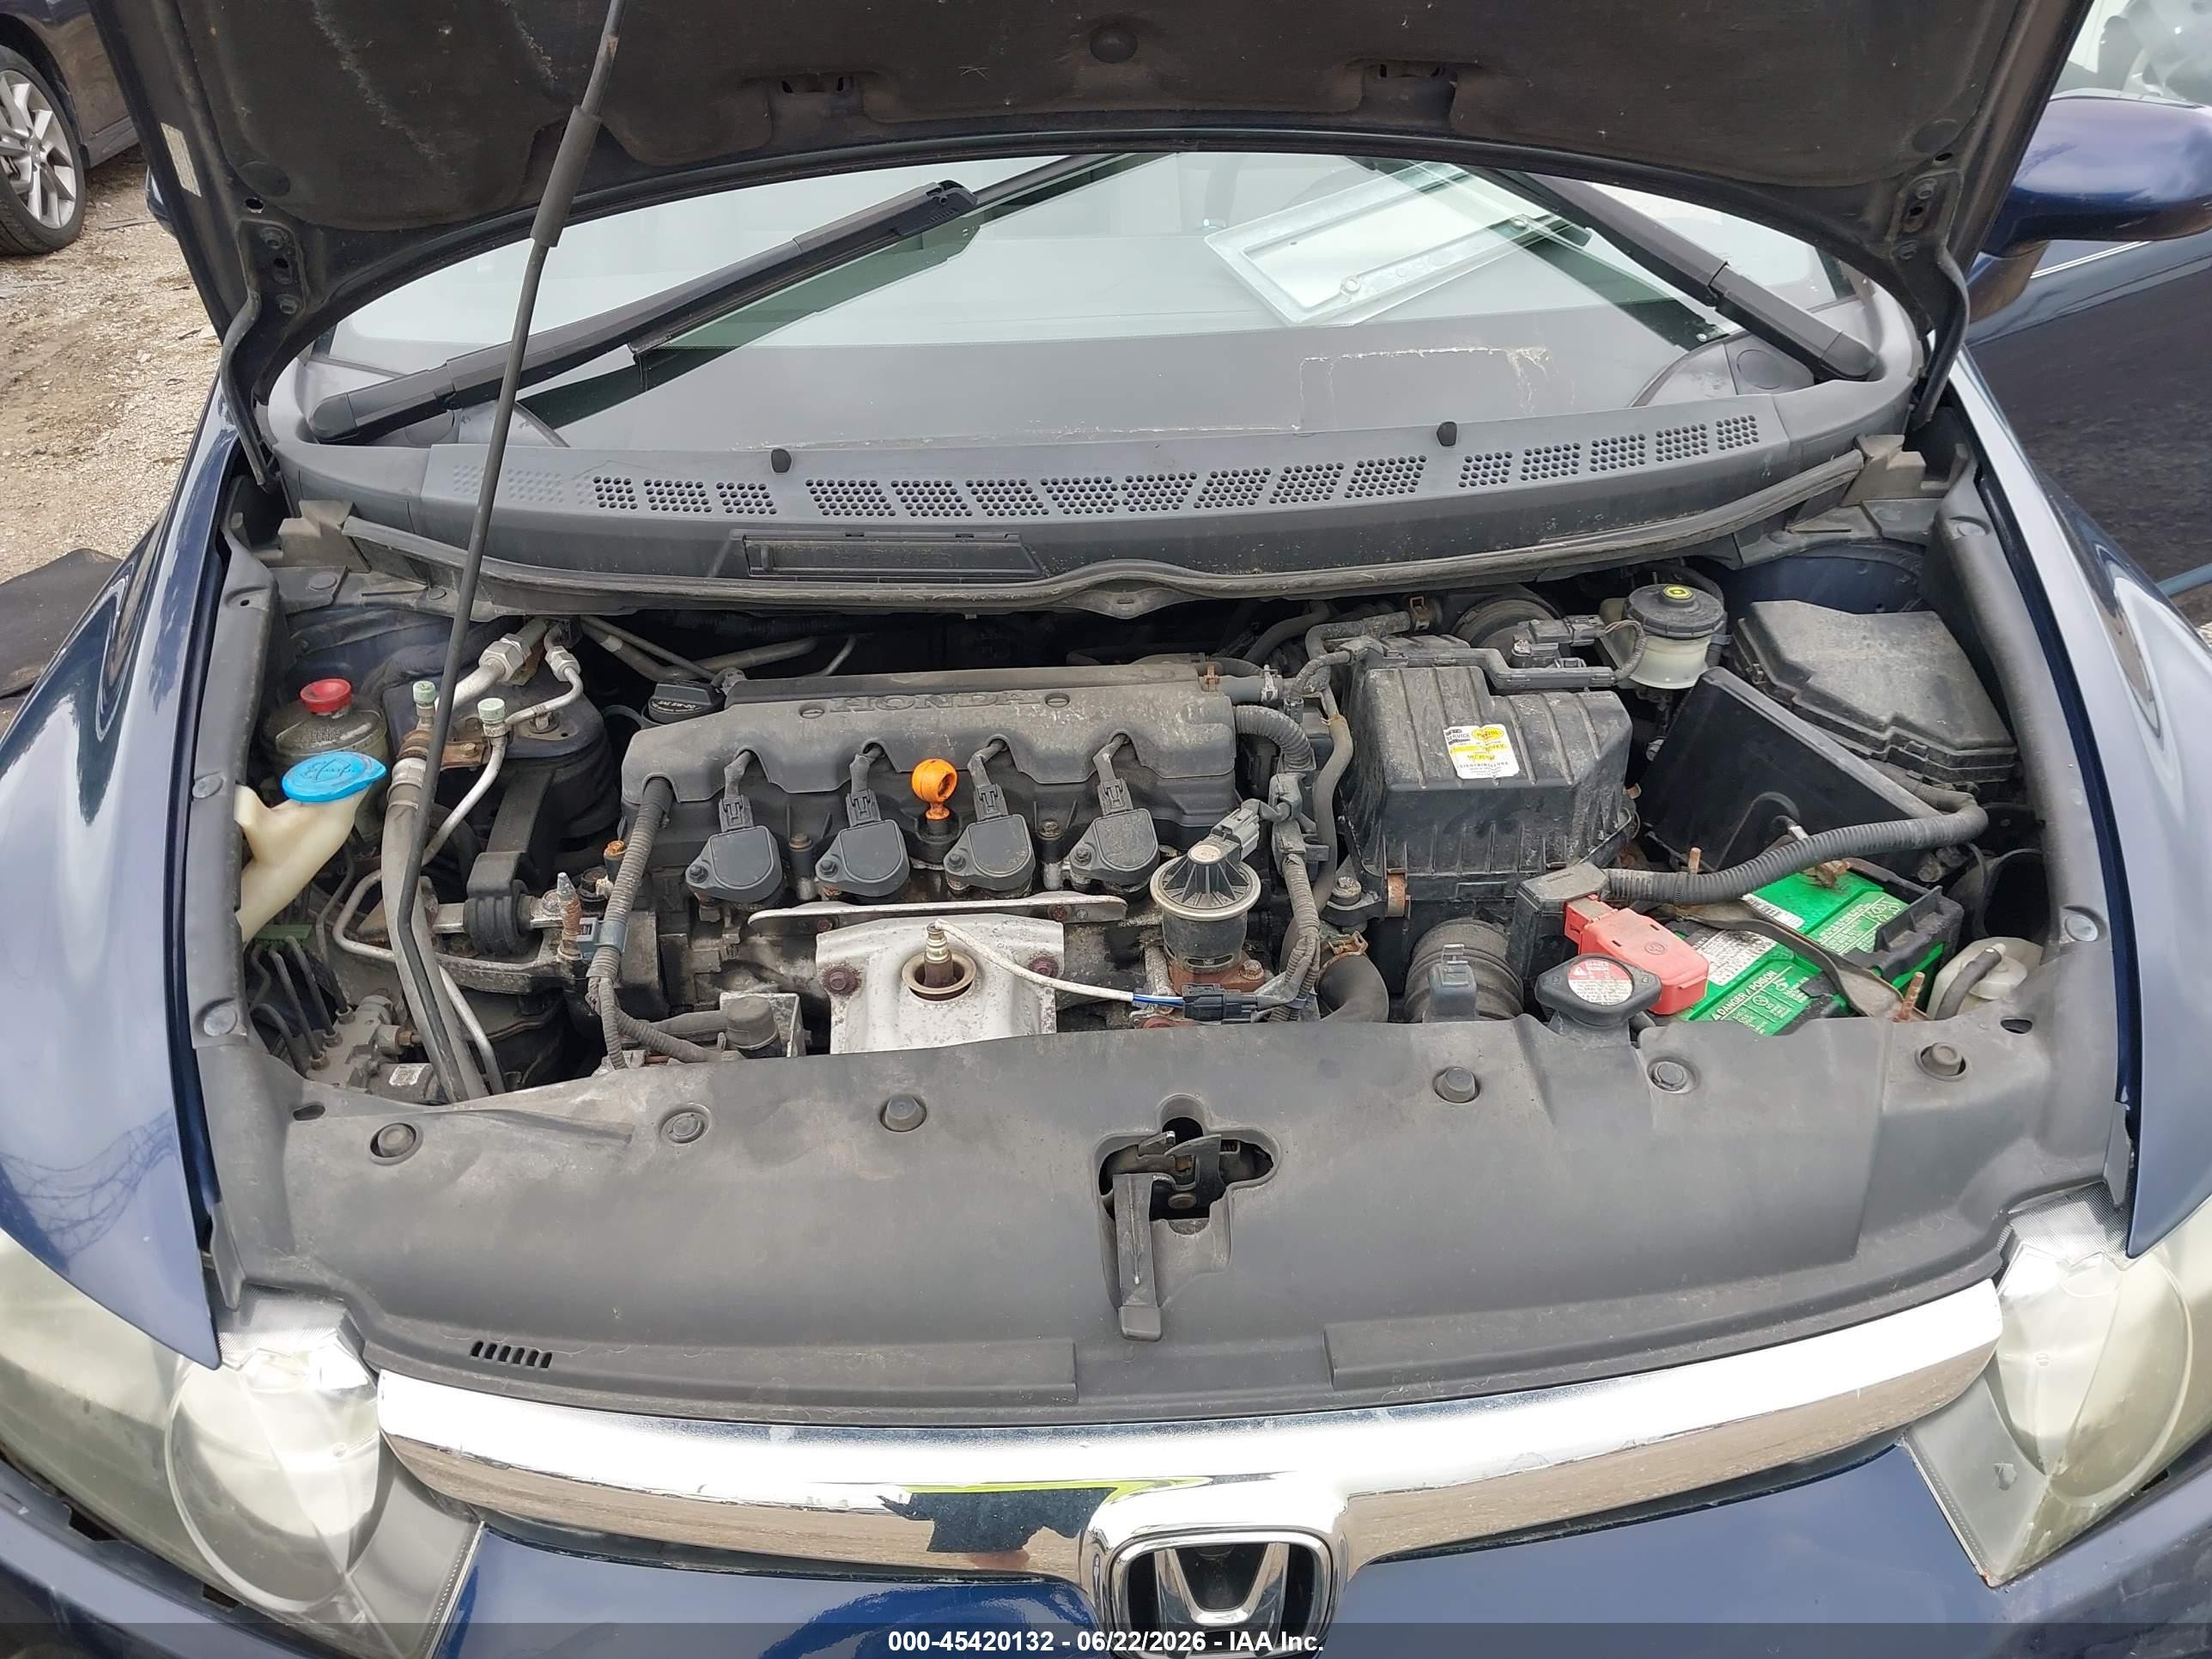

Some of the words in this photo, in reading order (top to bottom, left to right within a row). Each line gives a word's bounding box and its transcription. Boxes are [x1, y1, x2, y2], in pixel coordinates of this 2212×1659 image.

[830, 691, 1041, 712] HONDA
[1717, 993, 1747, 1016] DANGER
[1748, 969, 1778, 991] POISON
